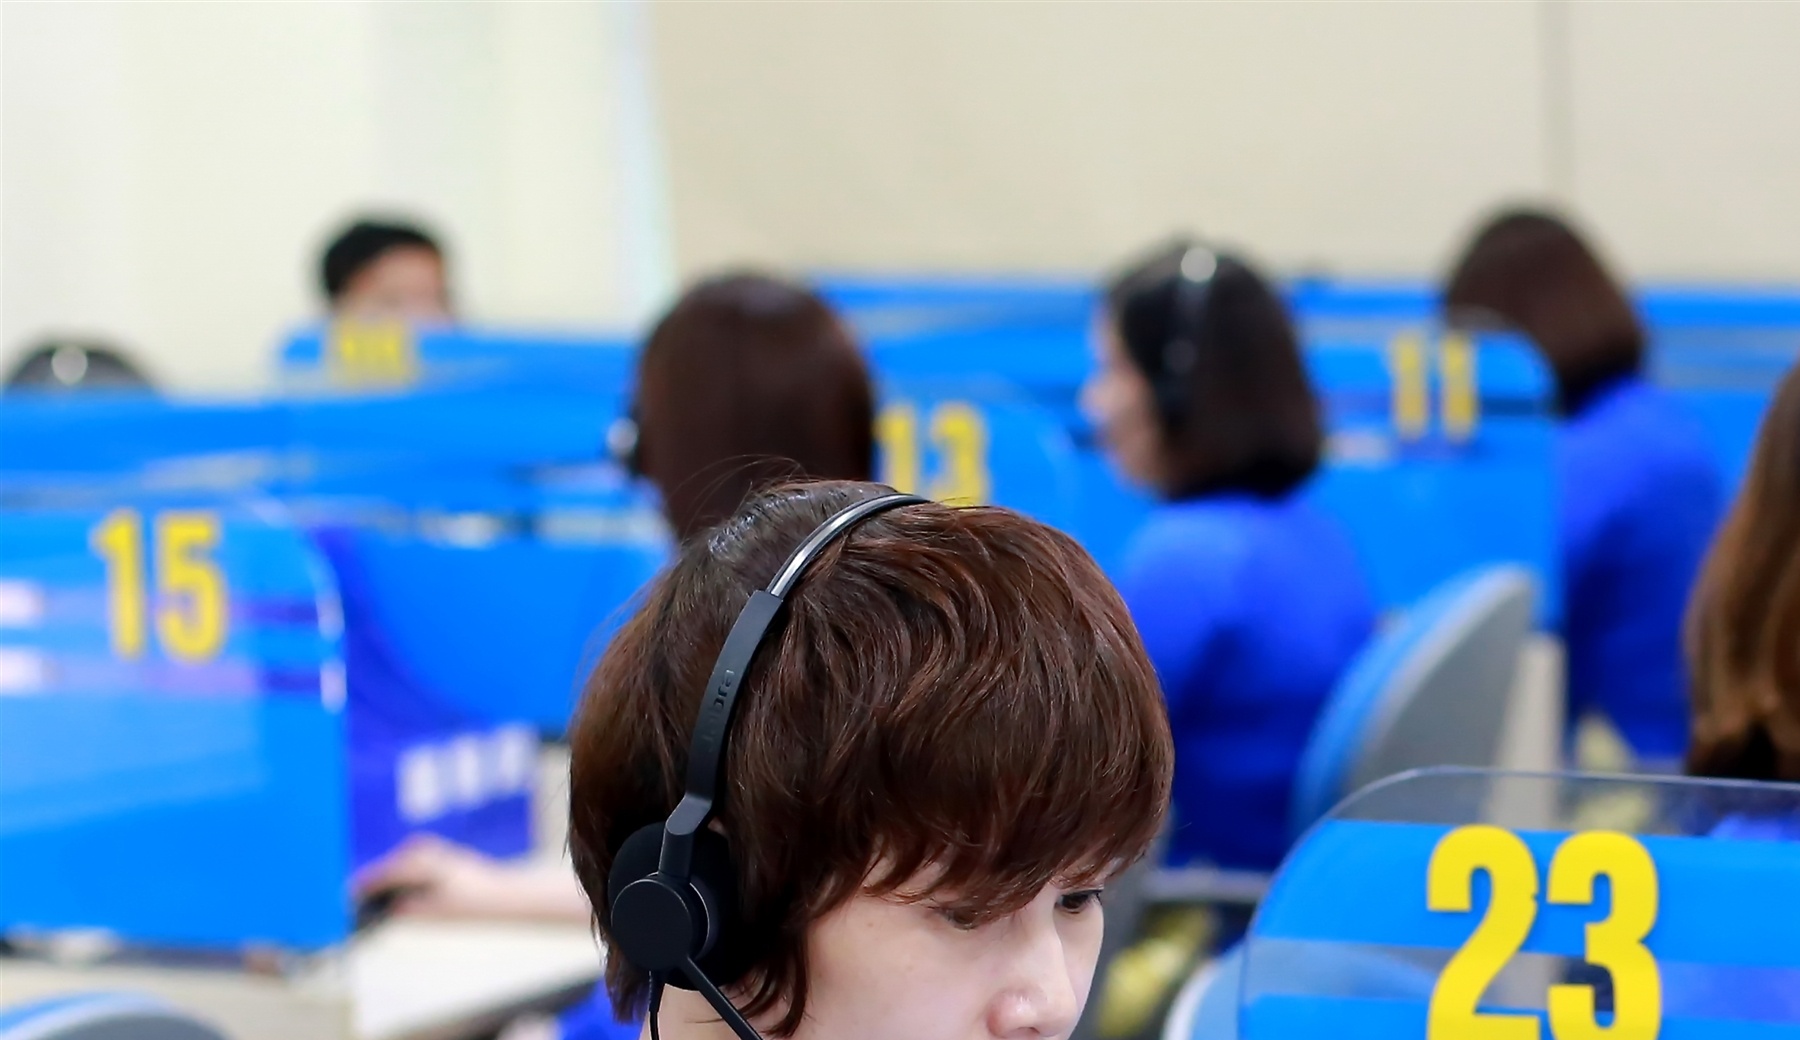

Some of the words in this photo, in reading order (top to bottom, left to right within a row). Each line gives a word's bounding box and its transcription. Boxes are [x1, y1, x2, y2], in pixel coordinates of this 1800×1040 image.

[1393, 334, 1477, 436] 11
[874, 411, 983, 506] 13
[94, 511, 228, 661] 15
